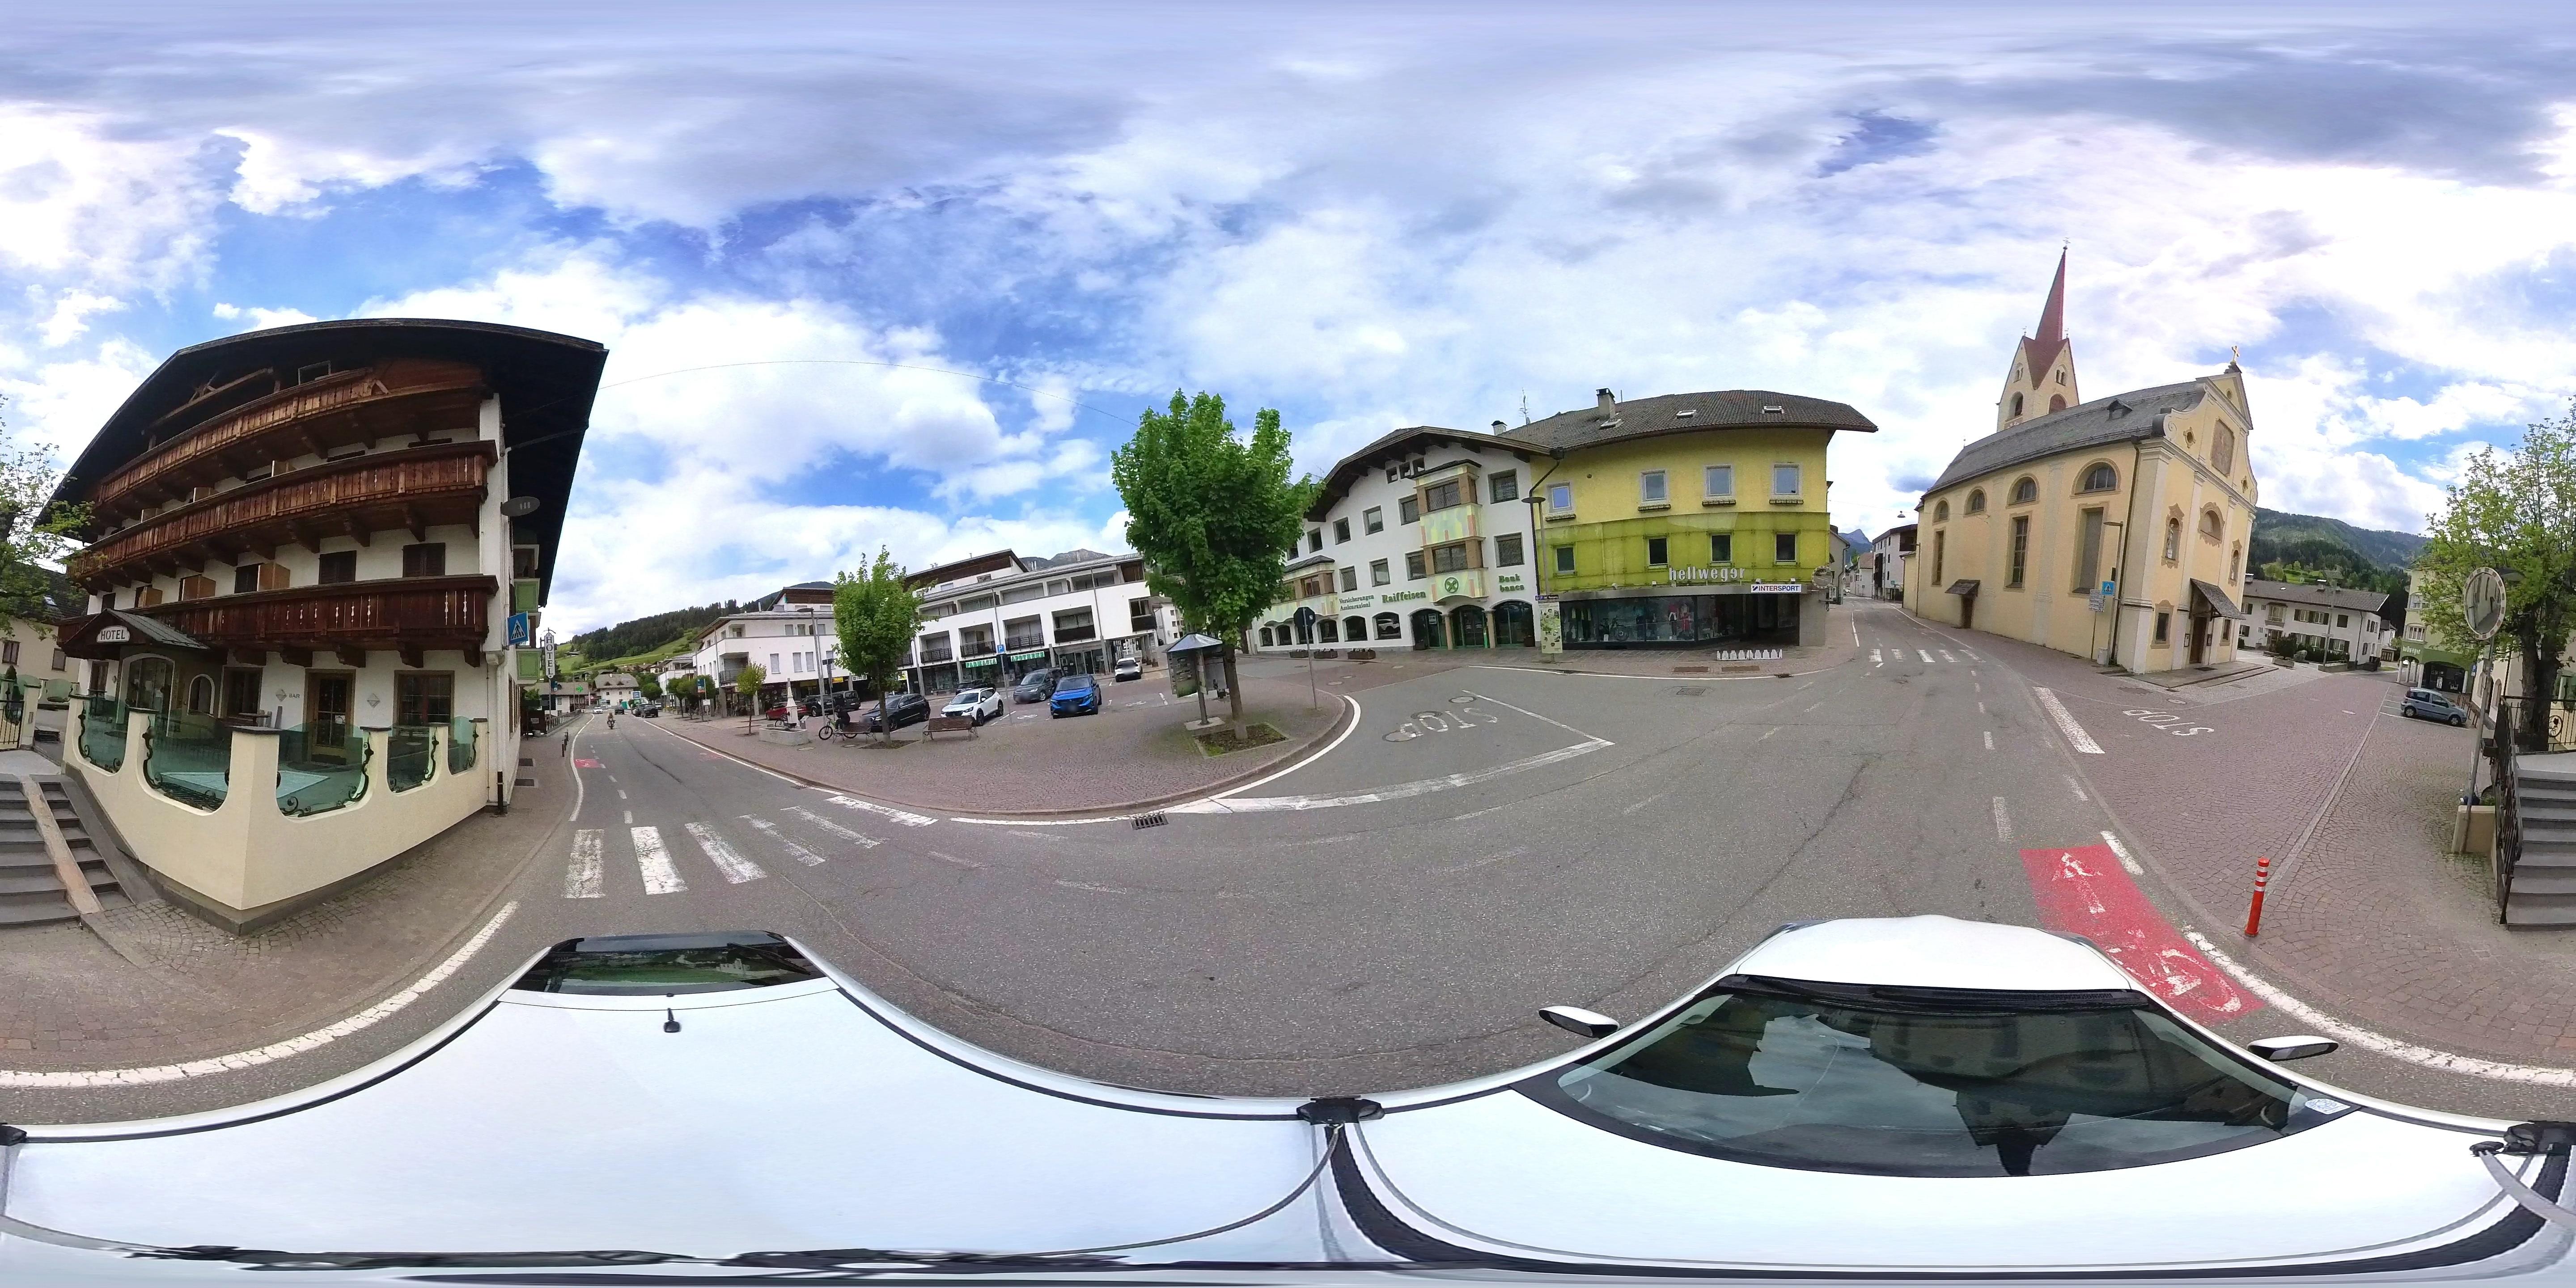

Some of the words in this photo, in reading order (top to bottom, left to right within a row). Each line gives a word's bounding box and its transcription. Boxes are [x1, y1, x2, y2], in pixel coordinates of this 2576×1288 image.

[1499, 573, 1520, 583] Bank
[1669, 566, 1745, 582] hellweger
[1500, 585, 1525, 593] banca
[1339, 594, 1374, 604] Versicherungen
[1381, 591, 1427, 603] Raiffeisen
[101, 630, 125, 640] HOTEL
[2123, 710, 2215, 736] STOP
